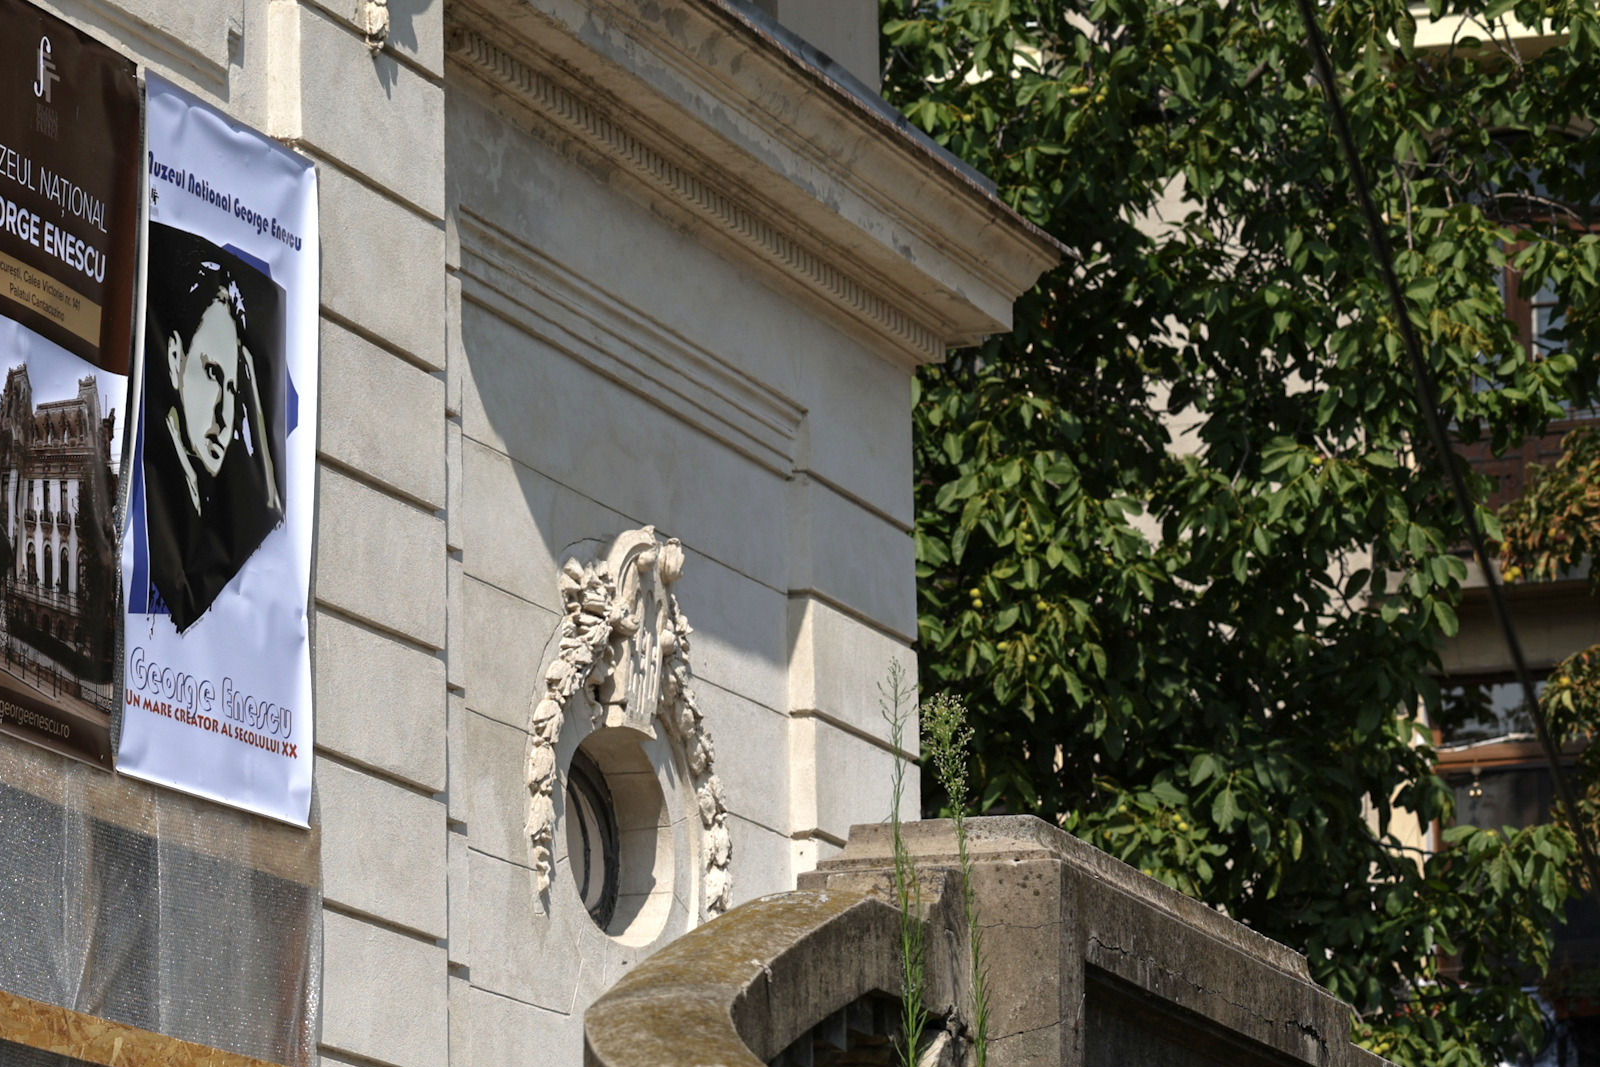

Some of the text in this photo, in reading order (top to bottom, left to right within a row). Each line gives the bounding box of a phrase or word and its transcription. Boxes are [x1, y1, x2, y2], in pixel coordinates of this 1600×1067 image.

[40, 166, 107, 233] NAȚIONAL
[188, 173, 231, 214] Național
[234, 198, 269, 235] George
[271, 217, 302, 251] Enescu
[44, 221, 106, 283] ENESCU
[9, 282, 64, 321] Palatul Cantacuzino
[23, 270, 41, 289] Calea
[42, 280, 64, 302] Victoriei
[125, 688, 140, 708] UN
[142, 697, 172, 718] MARE
[174, 708, 219, 733] CREATOR
[221, 721, 233, 738] AL
[234, 728, 280, 754] SECOLULUI
[281, 741, 298, 759] XX
[130, 646, 292, 739] George Enescu
